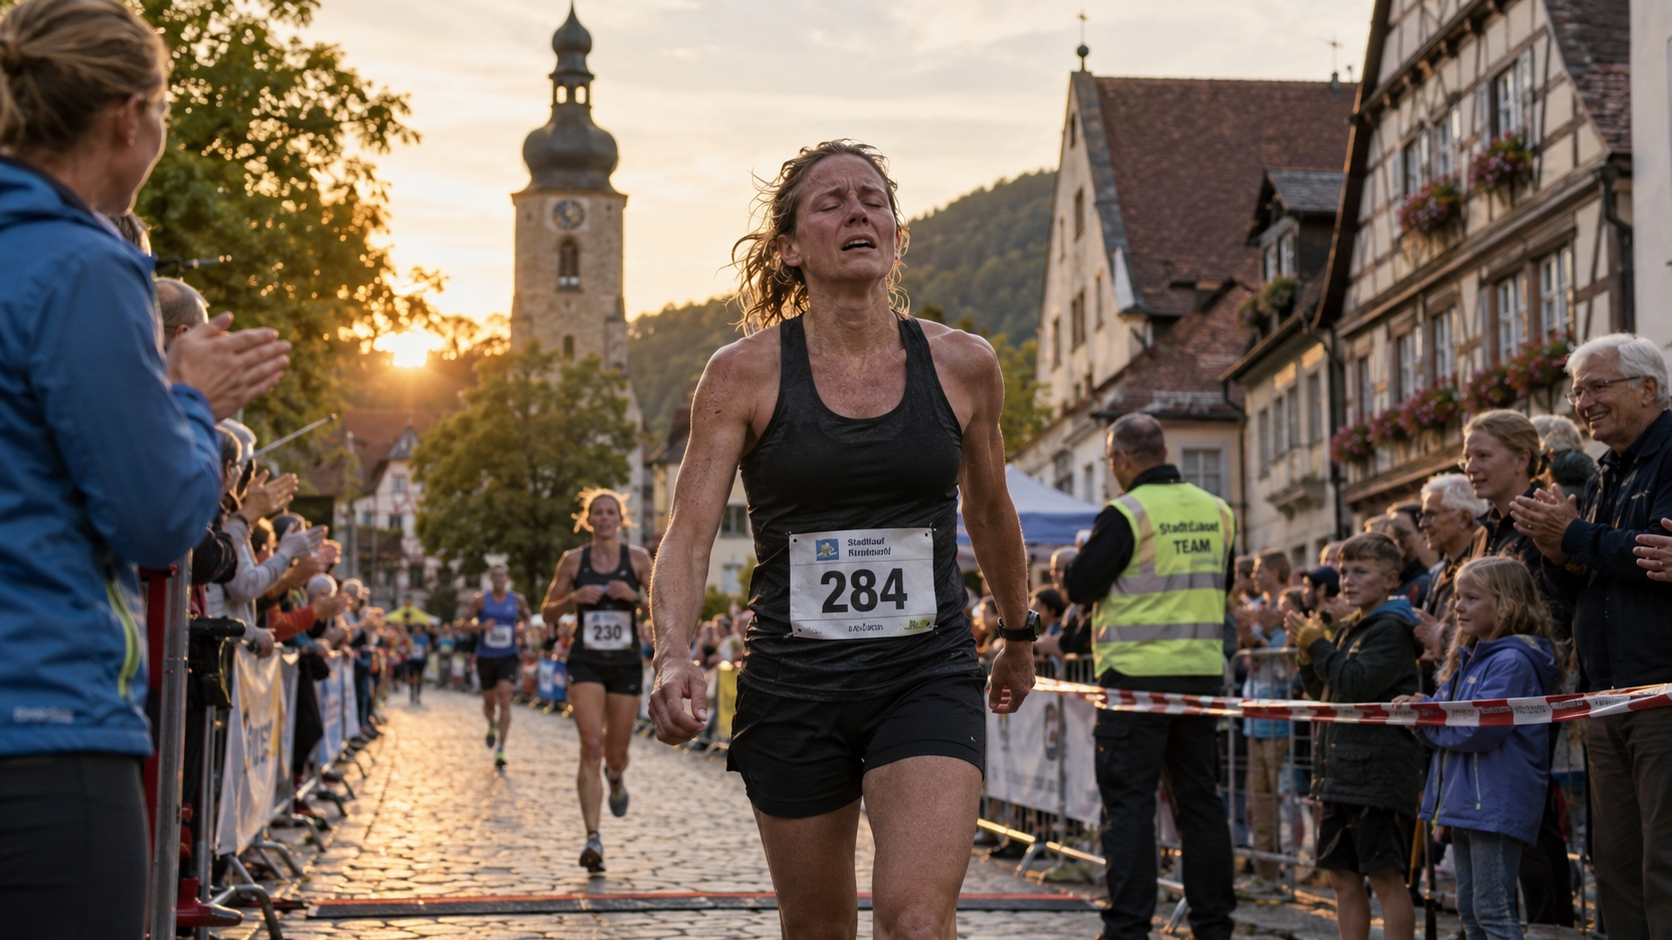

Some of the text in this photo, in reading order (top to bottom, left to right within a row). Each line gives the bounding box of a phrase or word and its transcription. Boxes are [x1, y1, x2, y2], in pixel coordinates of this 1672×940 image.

[1173, 538, 1211, 555] TEAM
[820, 567, 908, 614] 284
[593, 624, 623, 642] 230
